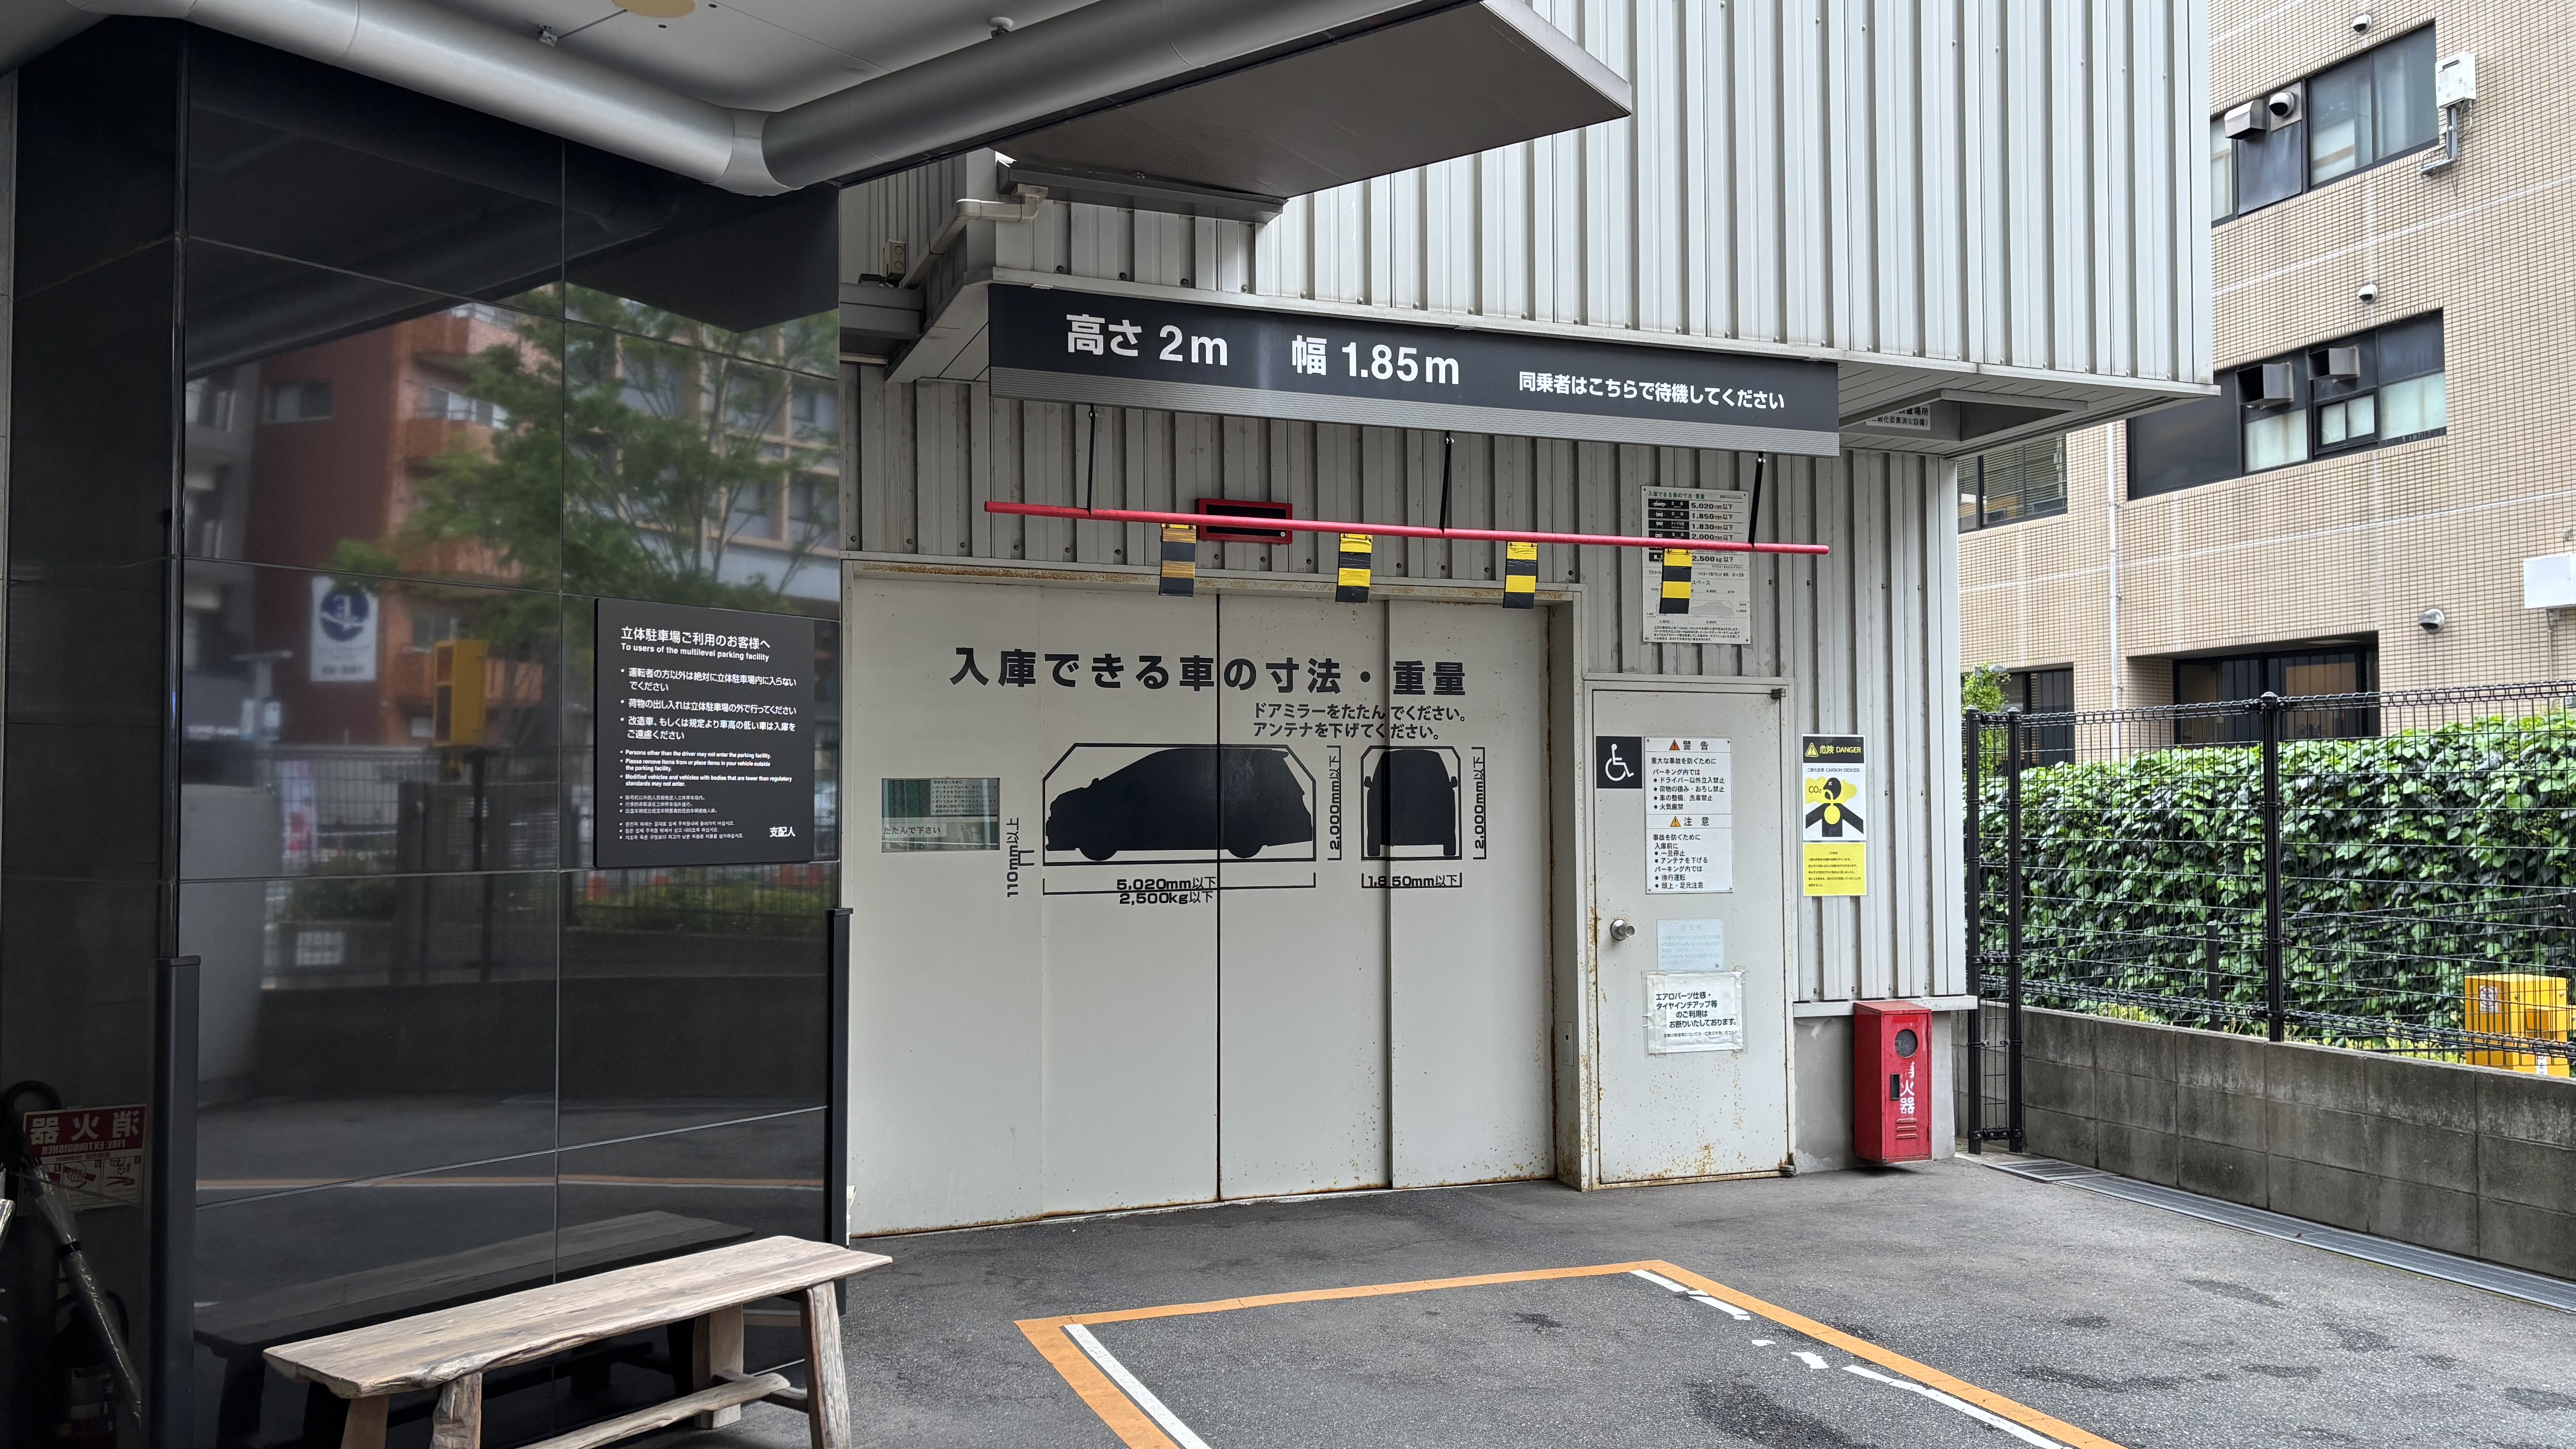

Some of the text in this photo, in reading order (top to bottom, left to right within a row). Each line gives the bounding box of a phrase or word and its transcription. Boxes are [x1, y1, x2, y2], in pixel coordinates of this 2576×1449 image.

[1066, 313, 1459, 385] 高さ 2m 幅 1.85m
[1518, 371, 1785, 410] 同乗者はこちらで待機してください
[621, 626, 771, 650] 立体駐車場ご利用のお客様へ
[633, 644, 654, 653] users
[657, 645, 664, 653] of
[667, 646, 678, 654] the
[680, 648, 715, 657] multilevel
[718, 651, 744, 660] parking
[746, 652, 769, 662] facility
[628, 667, 797, 686] 運転者の方以外は絶対に立体駐車場内に入らない
[949, 647, 1466, 696] 入庫できる車の寸法・重量
[630, 681, 669, 691] でください
[628, 699, 797, 715] 荷物の出し入れは立体駐車場の外で行ってください
[1254, 702, 1466, 723] ドアミラーをたたんでください。
[628, 716, 796, 731] 改造車、もしくは規定より車高の低い車は入庫を
[1253, 722, 1440, 740] アンテナを下げてください。
[627, 730, 685, 740] ご遠慮ください
[1820, 745, 1835, 754] 危険
[1329, 755, 1340, 851] 2,000mm以下
[1473, 756, 1485, 850] 2,000mm以下
[769, 826, 796, 837] 支配人
[1117, 876, 1216, 891] 5,020mm以下
[1119, 891, 1213, 905] 2,500kg以下
[1676, 1010, 1708, 1018] のご利用は
[1669, 1018, 1737, 1028] お断りいたしております。
